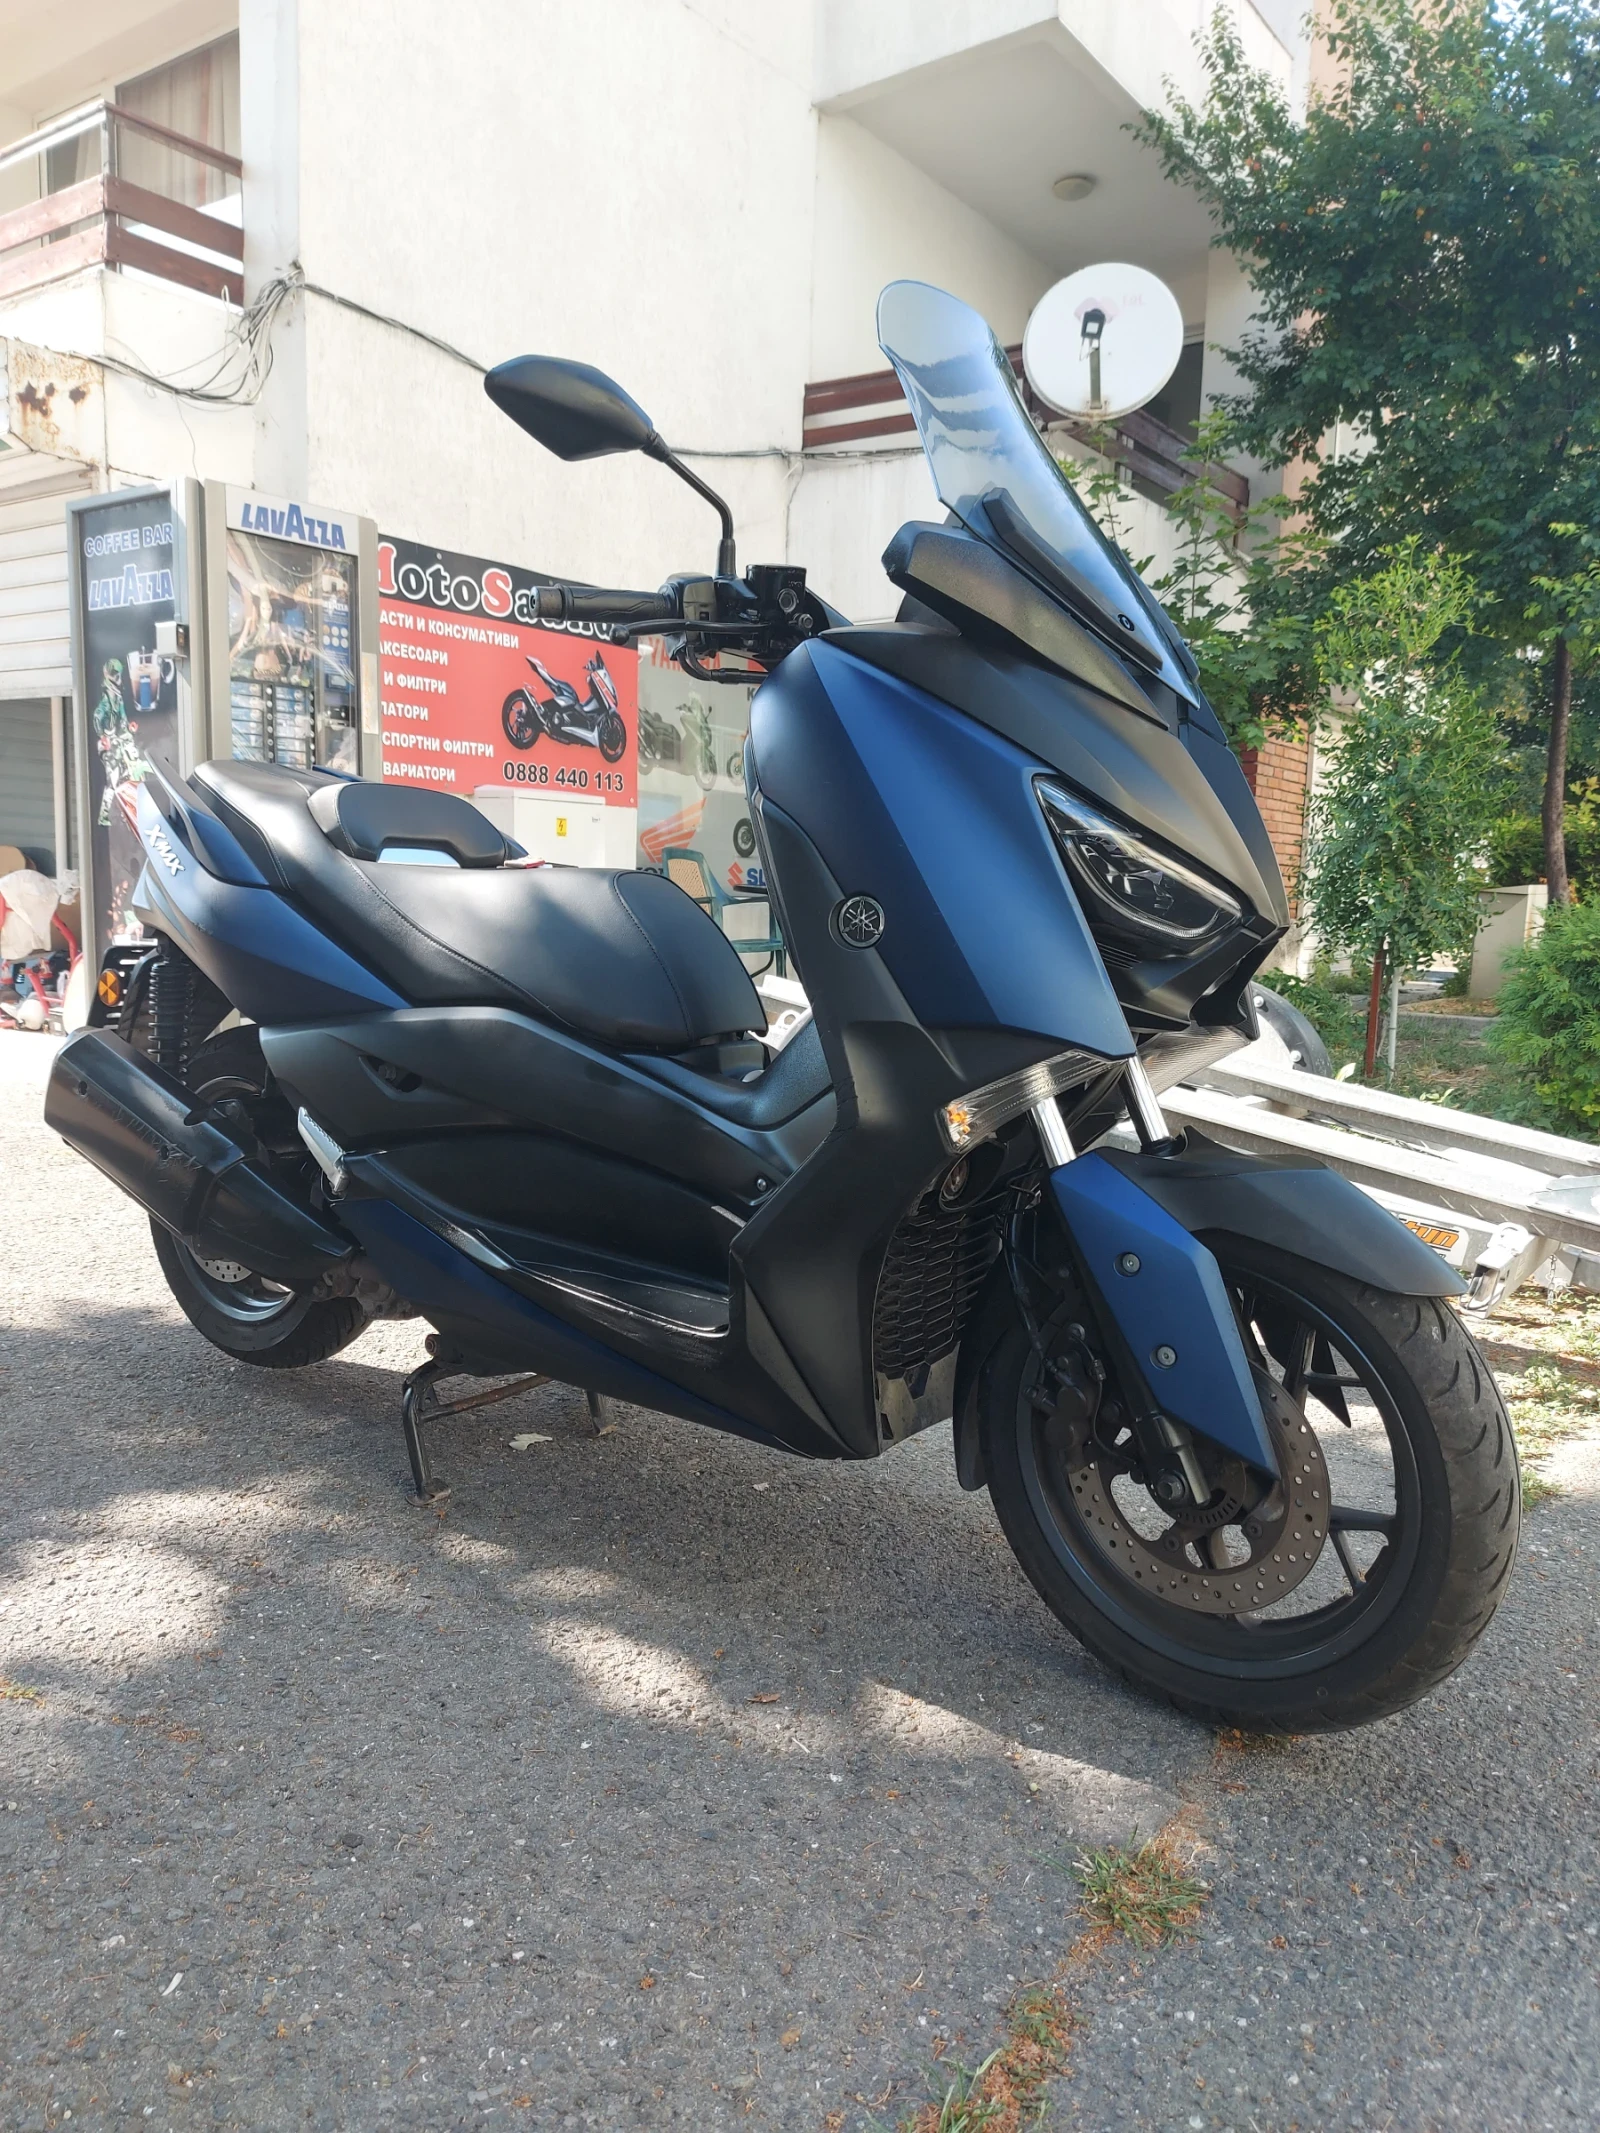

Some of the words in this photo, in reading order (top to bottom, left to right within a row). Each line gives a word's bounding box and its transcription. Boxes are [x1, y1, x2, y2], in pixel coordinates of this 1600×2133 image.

[84, 528, 140, 557] COFFEE
[142, 522, 173, 547] BAR
[241, 503, 346, 550] LAVAZZA
[88, 563, 175, 611] LAVAZZA
[416, 617, 425, 632] И
[428, 618, 519, 649] КОНСУМАТИВИ
[383, 670, 393, 686] И
[396, 673, 447, 695] ФИЛТРИ
[382, 731, 440, 752] СПОРТНИ
[442, 739, 494, 758] ФИЛТРИ
[382, 761, 456, 782] ВАРИАТОРИ
[503, 761, 549, 785] 0888
[555, 767, 589, 789] 440
[594, 771, 625, 793] 113
